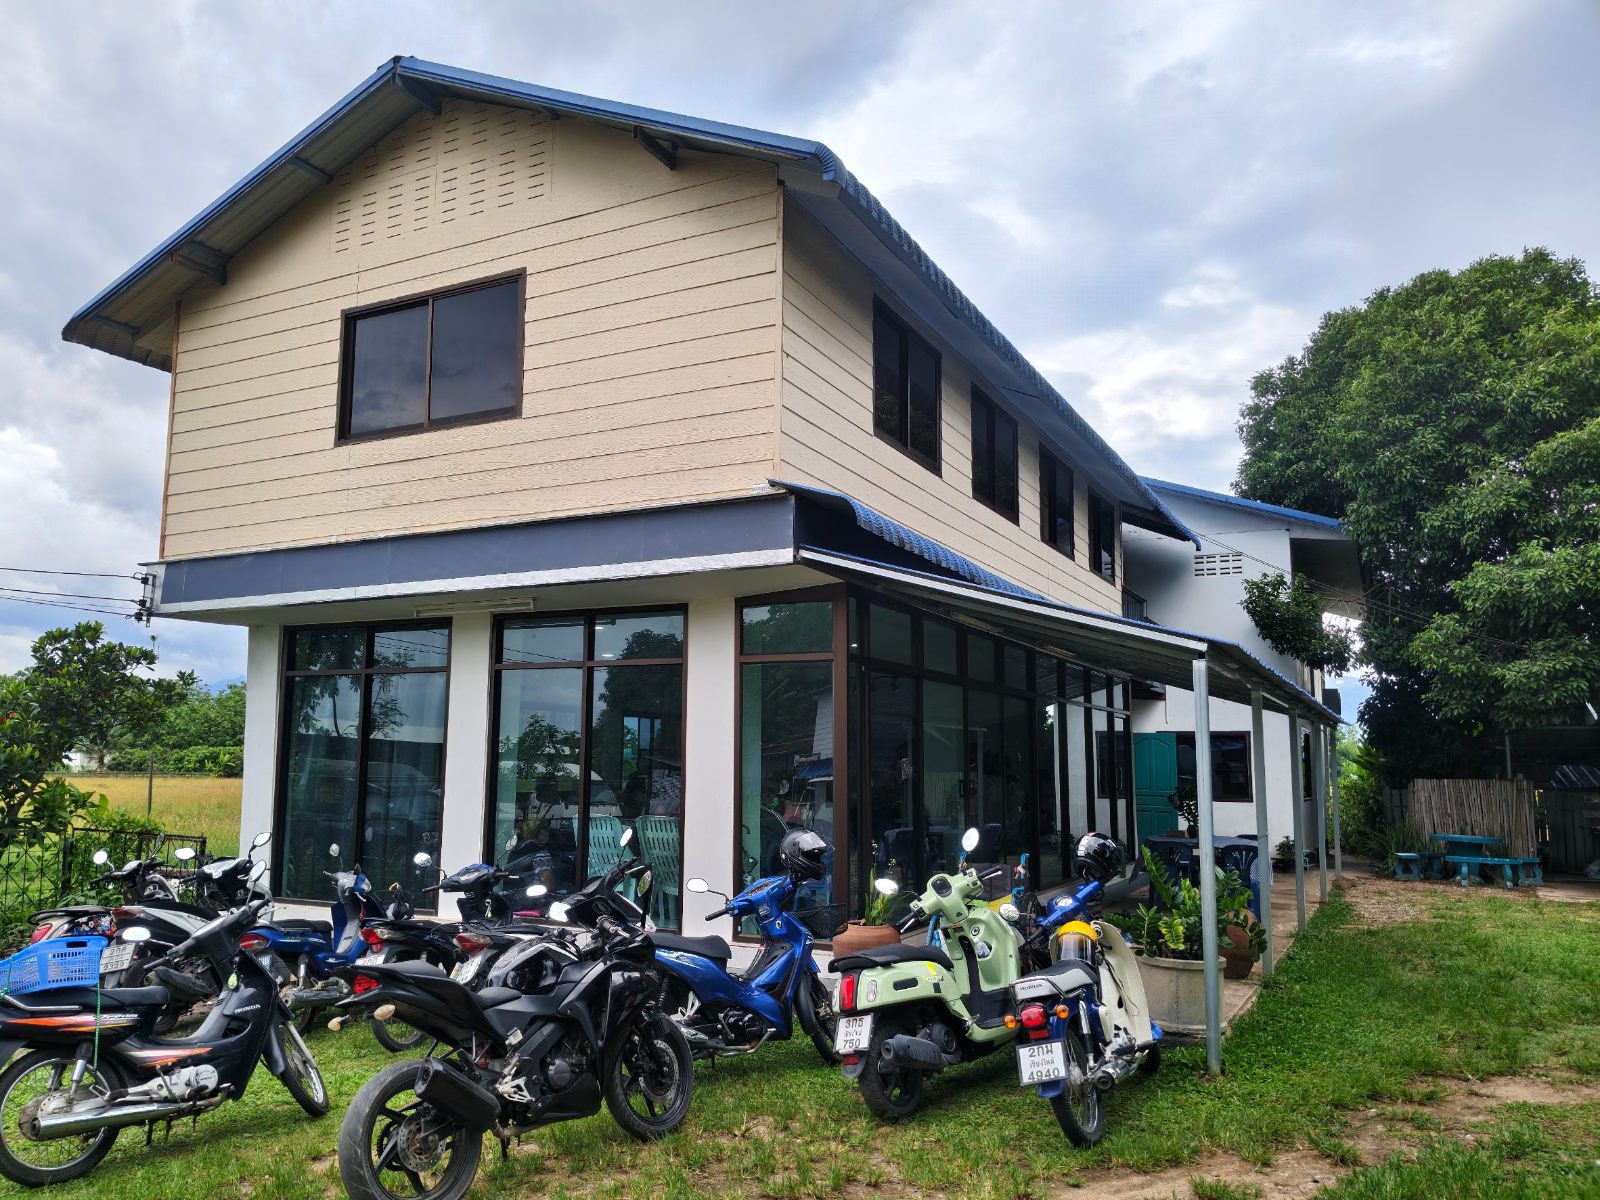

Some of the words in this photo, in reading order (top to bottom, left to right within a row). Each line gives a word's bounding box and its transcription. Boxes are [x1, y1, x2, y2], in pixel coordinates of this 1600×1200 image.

[234, 1004, 261, 1013] HONDA
[843, 1038, 860, 1049] 750
[1028, 1067, 1060, 1081] 4940
